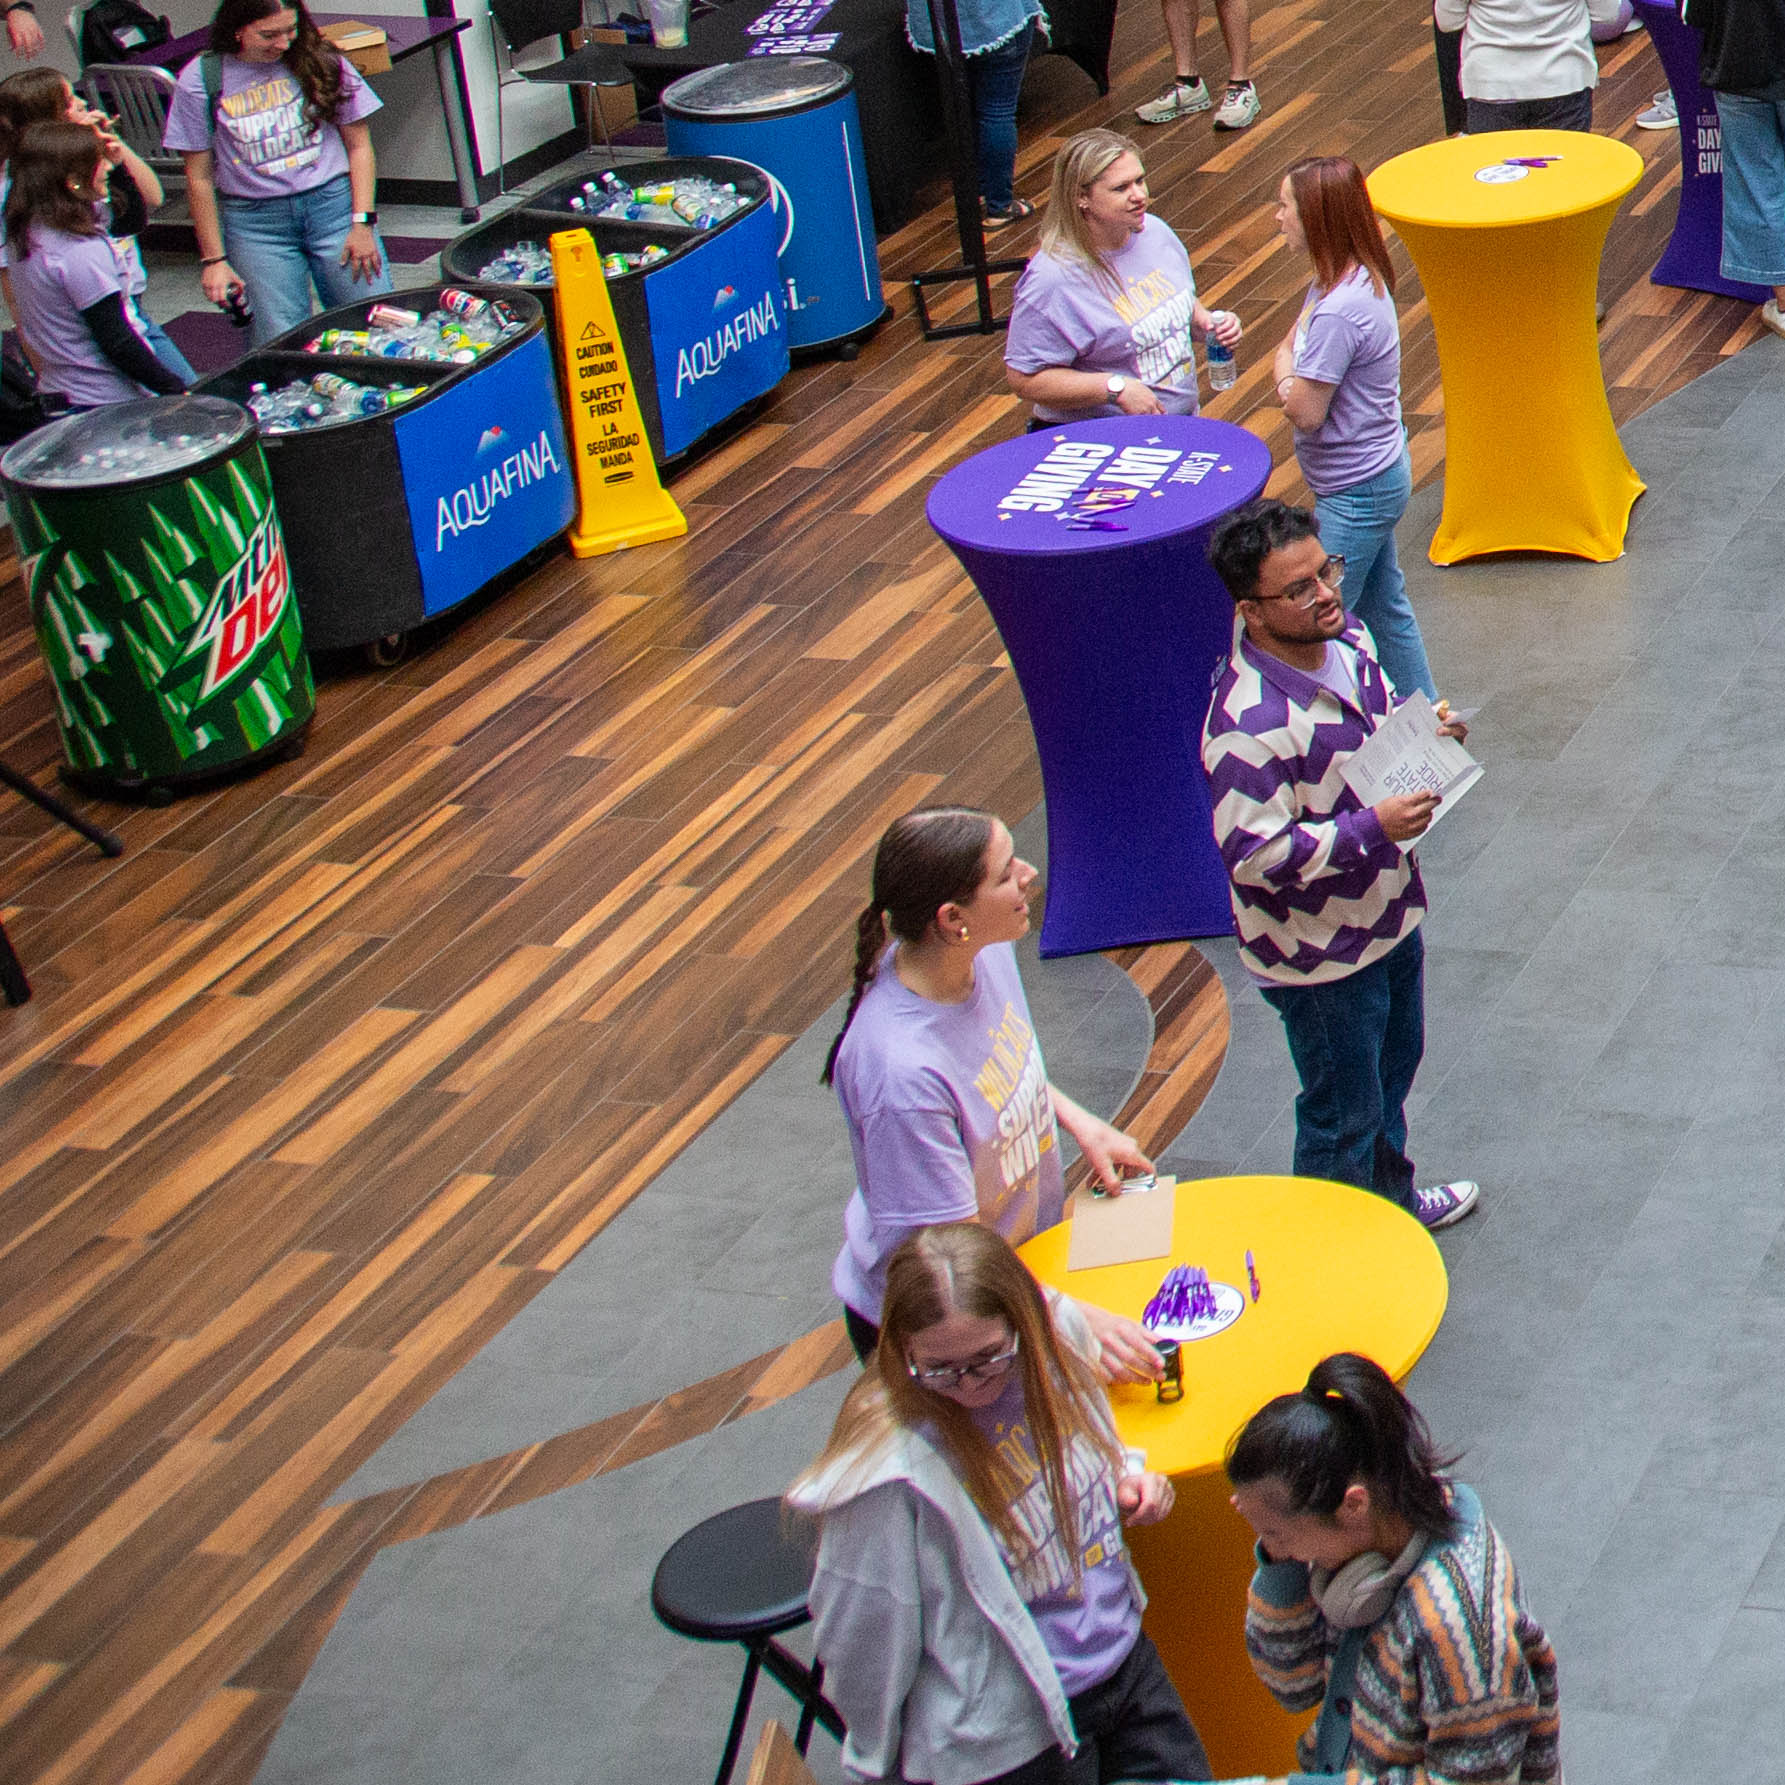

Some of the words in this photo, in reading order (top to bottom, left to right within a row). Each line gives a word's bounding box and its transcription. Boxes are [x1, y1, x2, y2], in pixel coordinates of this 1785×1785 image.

[221, 78, 294, 119] WILDCATS
[226, 97, 305, 144] SUPPOR
[575, 341, 614, 361] CAUTION
[675, 291, 779, 399] AQUAFINA
[579, 360, 618, 379] CUIDADO
[580, 382, 627, 403] SAFETY
[589, 399, 624, 419] FIRST
[586, 433, 641, 456] SEGURIDAD
[602, 421, 619, 436] LA
[599, 451, 635, 470] MANDA
[996, 441, 1116, 513] GIVING
[1096, 446, 1184, 490] DAY
[1166, 450, 1222, 486] K-STATE
[435, 430, 560, 553] AQUAFINA
[199, 546, 291, 699] DE
